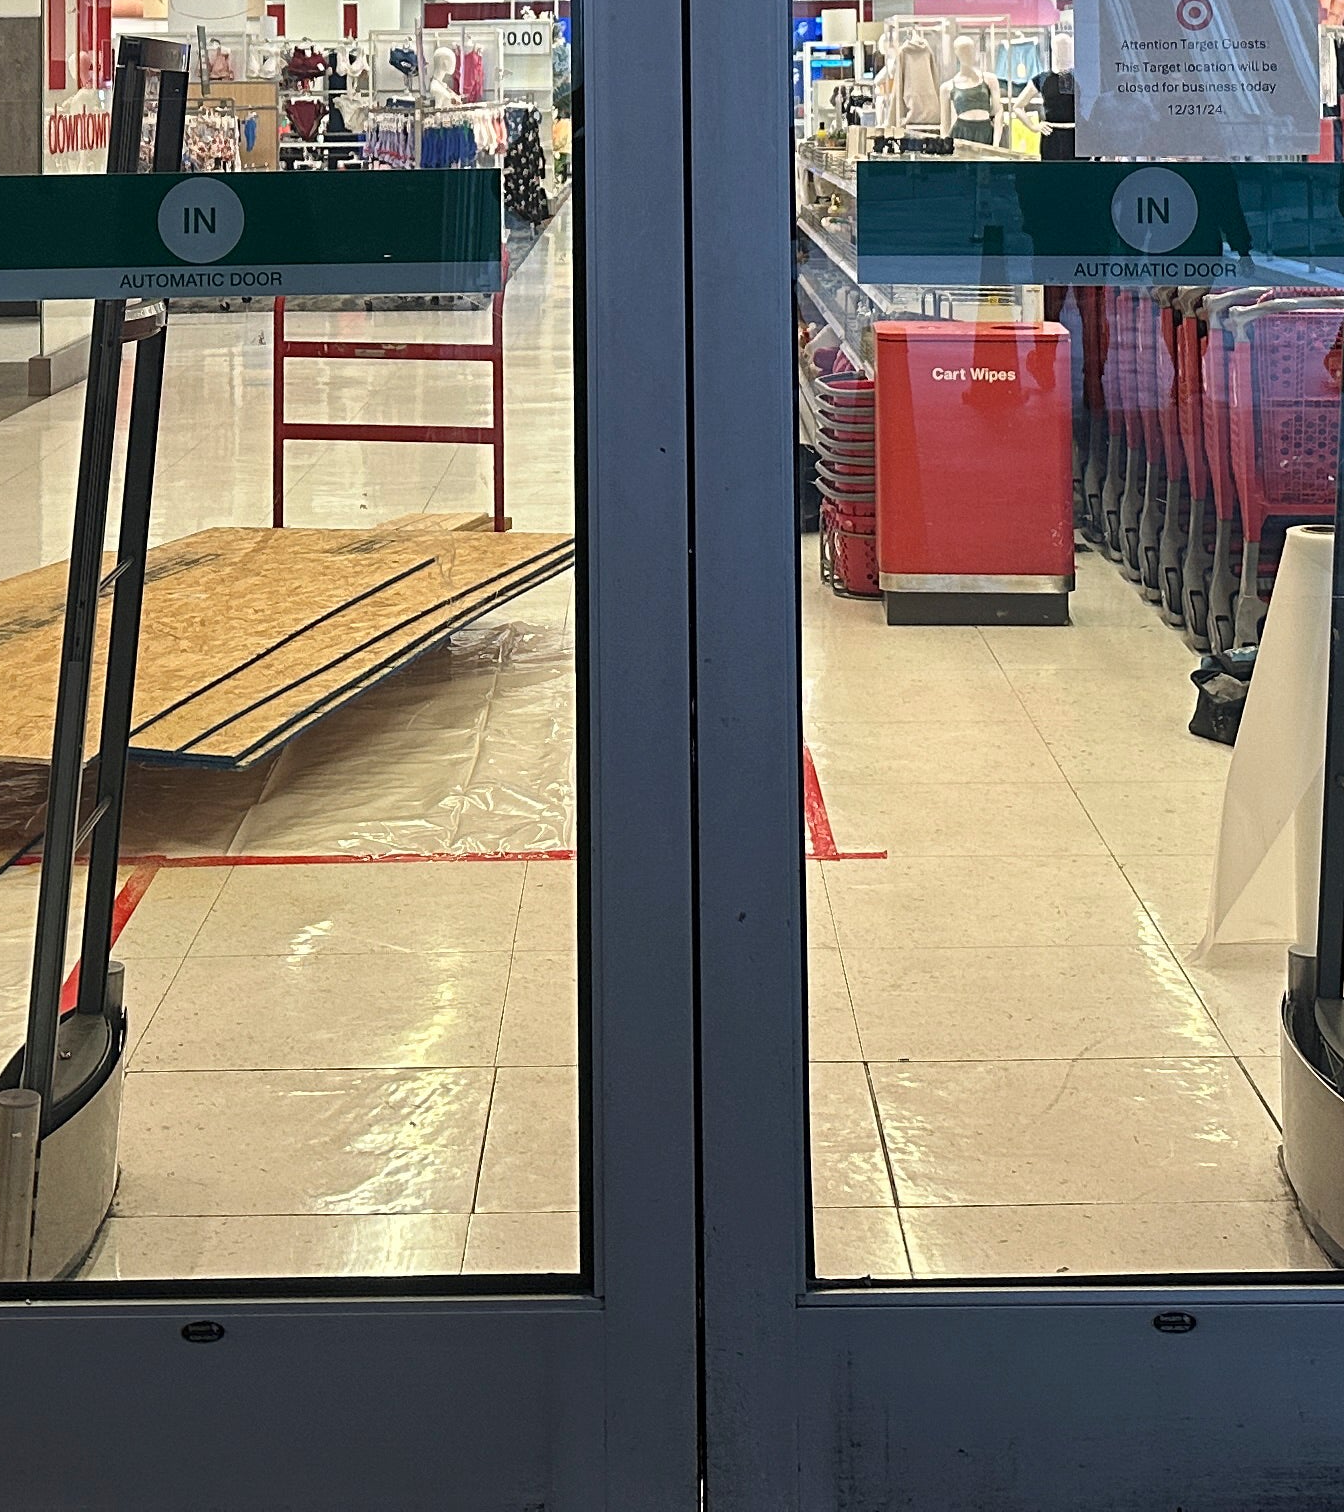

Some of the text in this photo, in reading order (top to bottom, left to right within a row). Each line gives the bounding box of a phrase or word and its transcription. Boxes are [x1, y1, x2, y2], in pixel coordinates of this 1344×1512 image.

[502, 31, 543, 46] 0.00
[1121, 39, 1178, 50] Attention
[1181, 39, 1219, 52] Target
[1115, 61, 1278, 75] This Target location will be
[1117, 81, 1277, 95] closed for business today
[49, 103, 110, 154] downtown
[1136, 196, 1170, 224] IN
[182, 206, 217, 235] IN
[1074, 262, 1237, 278] AUTOMATIC DOOR
[119, 271, 283, 289] AUTOMATIC DOOR
[932, 367, 1016, 383] Cart Wipes
